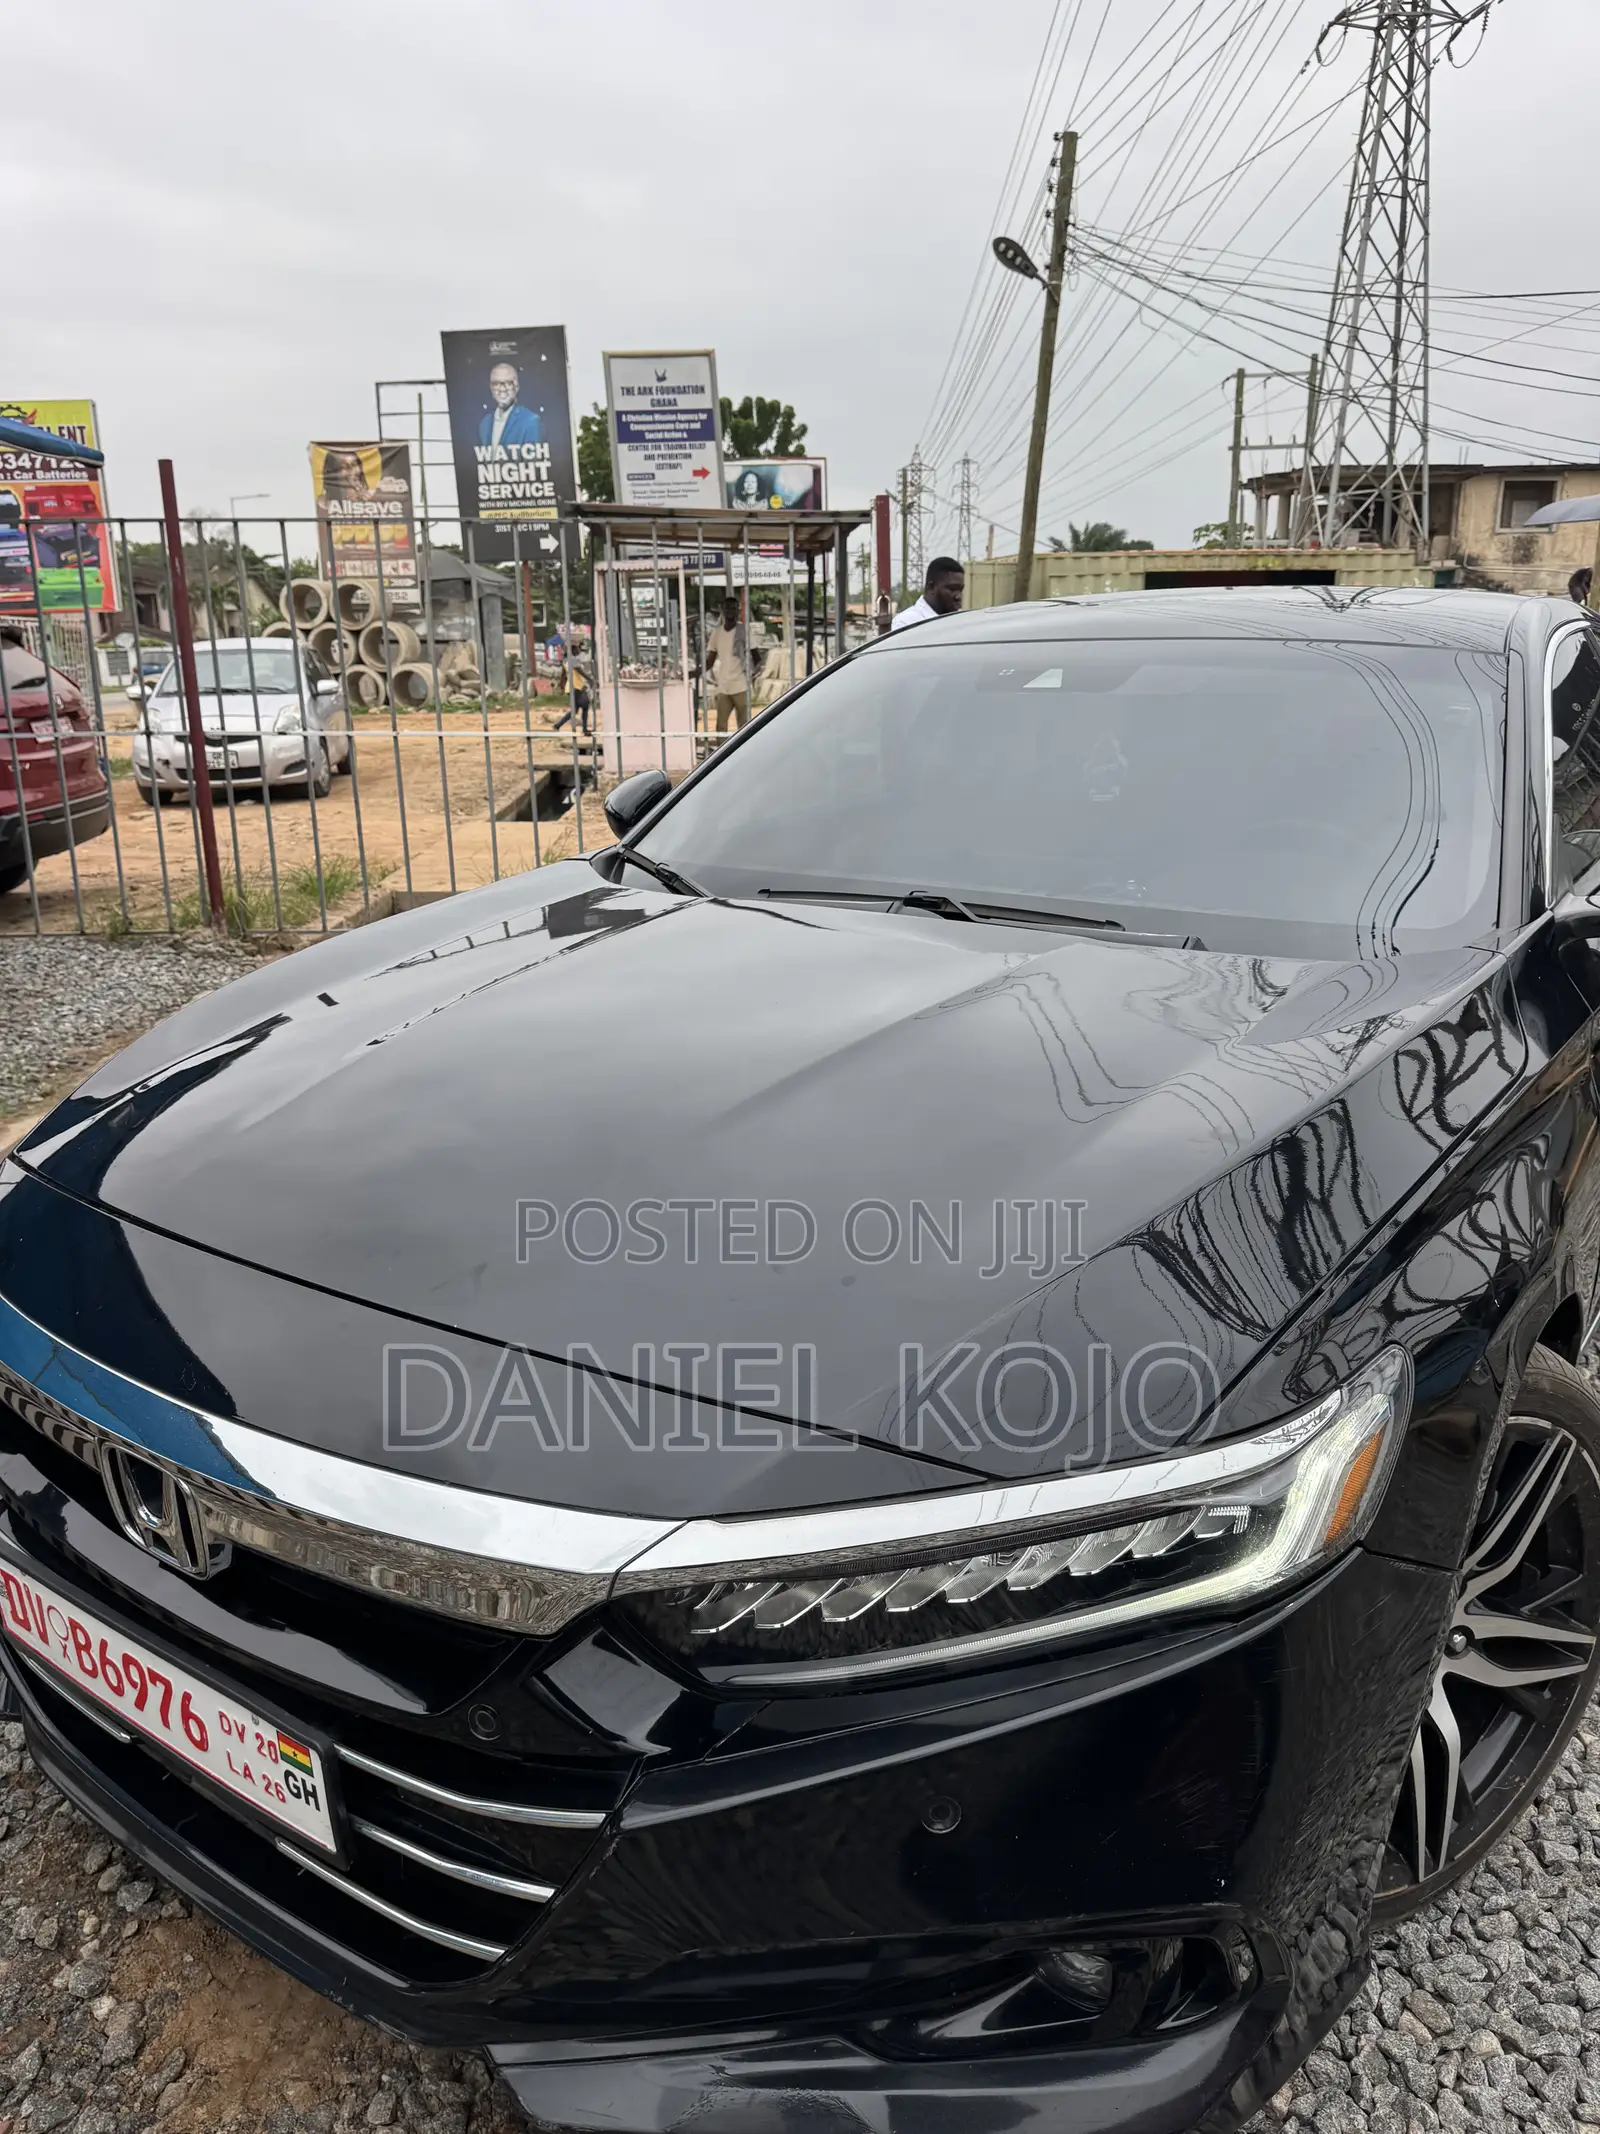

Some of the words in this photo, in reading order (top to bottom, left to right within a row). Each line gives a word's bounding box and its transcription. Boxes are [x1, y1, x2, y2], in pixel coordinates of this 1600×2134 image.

[620, 386, 636, 396] THE
[637, 386, 653, 396] ARK
[655, 384, 705, 396] FOUNDATION
[650, 398, 678, 408] GHANA
[474, 443, 550, 463] WATCH
[13, 470, 34, 480] Car
[36, 469, 88, 480] Batteries
[477, 460, 552, 484] NIGHT
[478, 482, 555, 501] SERVICE
[0, 1567, 49, 1646] DV
[218, 1710, 246, 1744] DV
[255, 1732, 279, 1764] 20
[226, 1750, 257, 1787] LA
[262, 1773, 287, 1804] 26
[283, 1769, 321, 1813] GH
